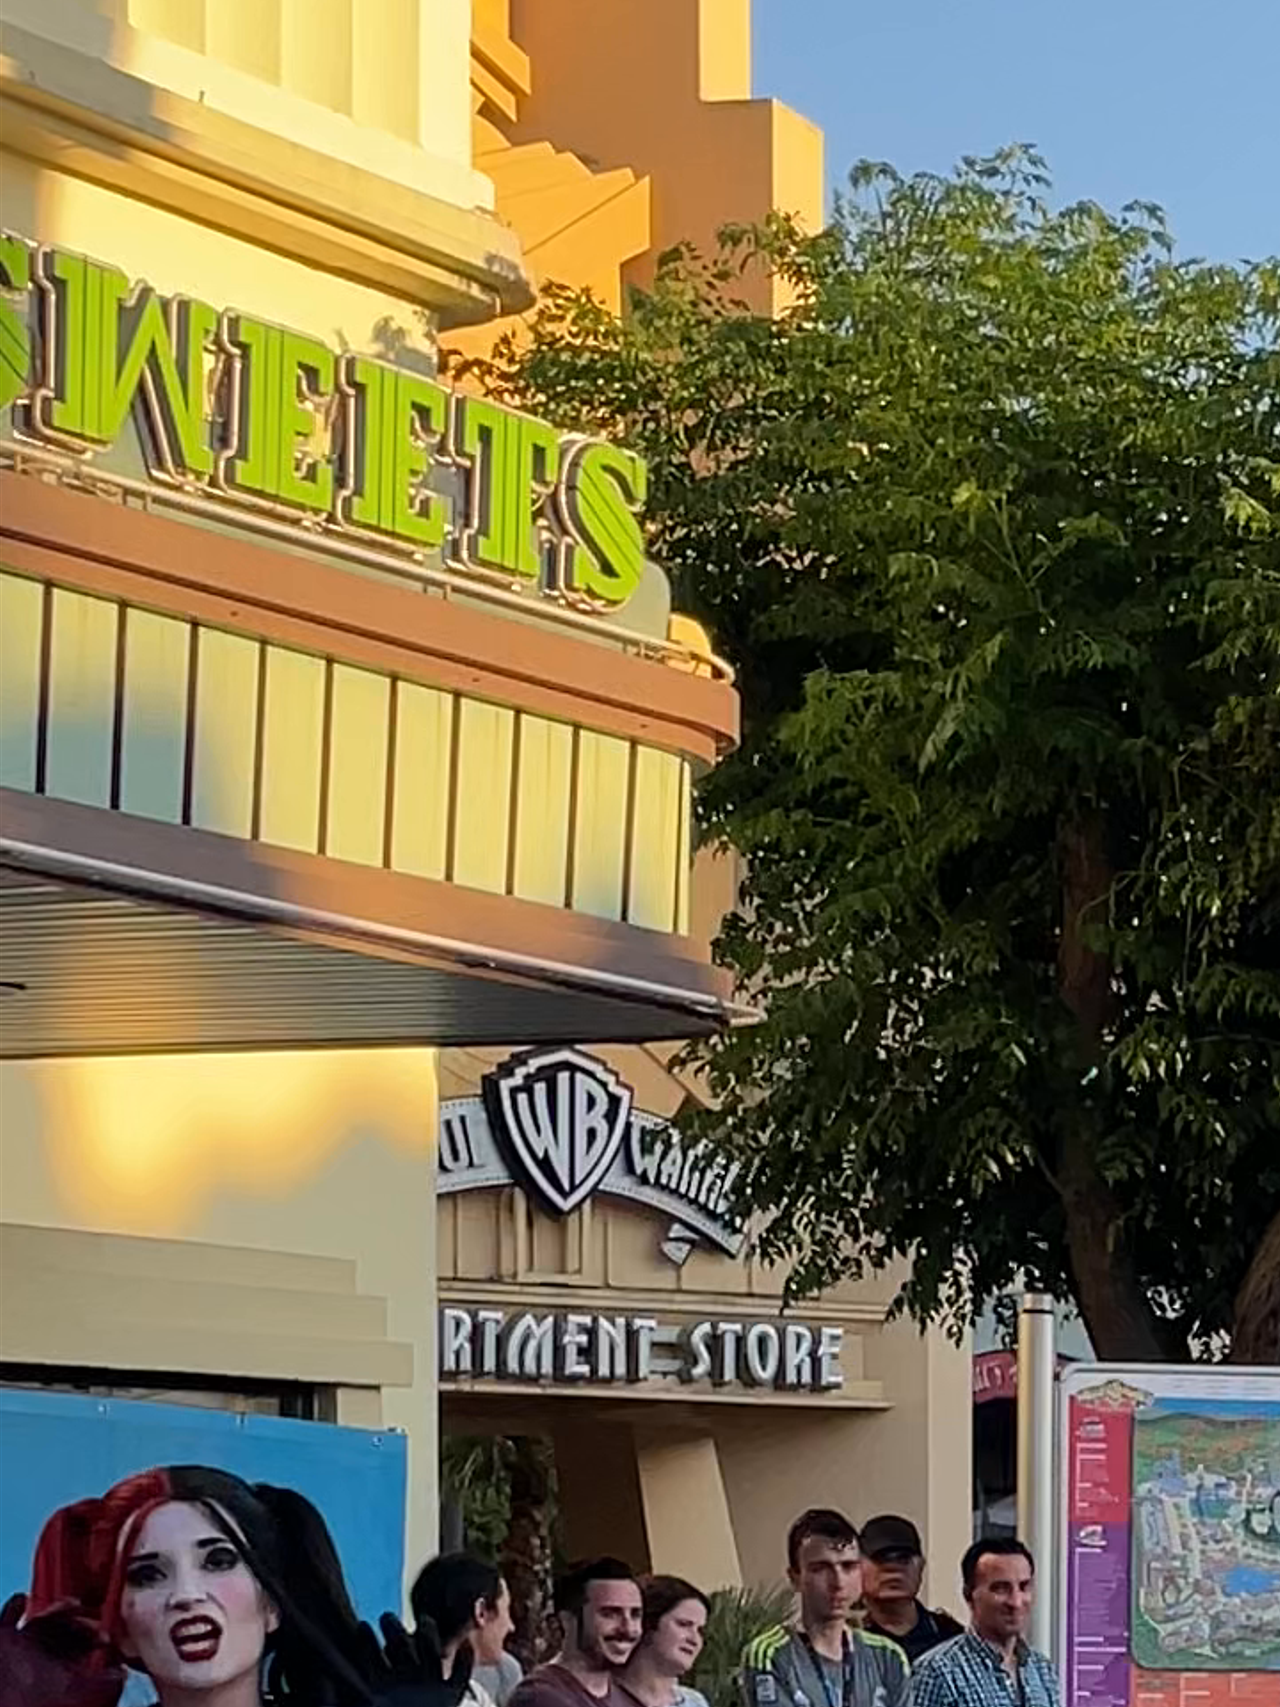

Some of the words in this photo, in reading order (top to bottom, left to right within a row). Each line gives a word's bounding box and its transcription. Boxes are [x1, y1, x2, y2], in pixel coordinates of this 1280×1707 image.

[516, 1070, 609, 1193] WB
[442, 1307, 656, 1379] RTMENT
[690, 1321, 844, 1387] STORE
